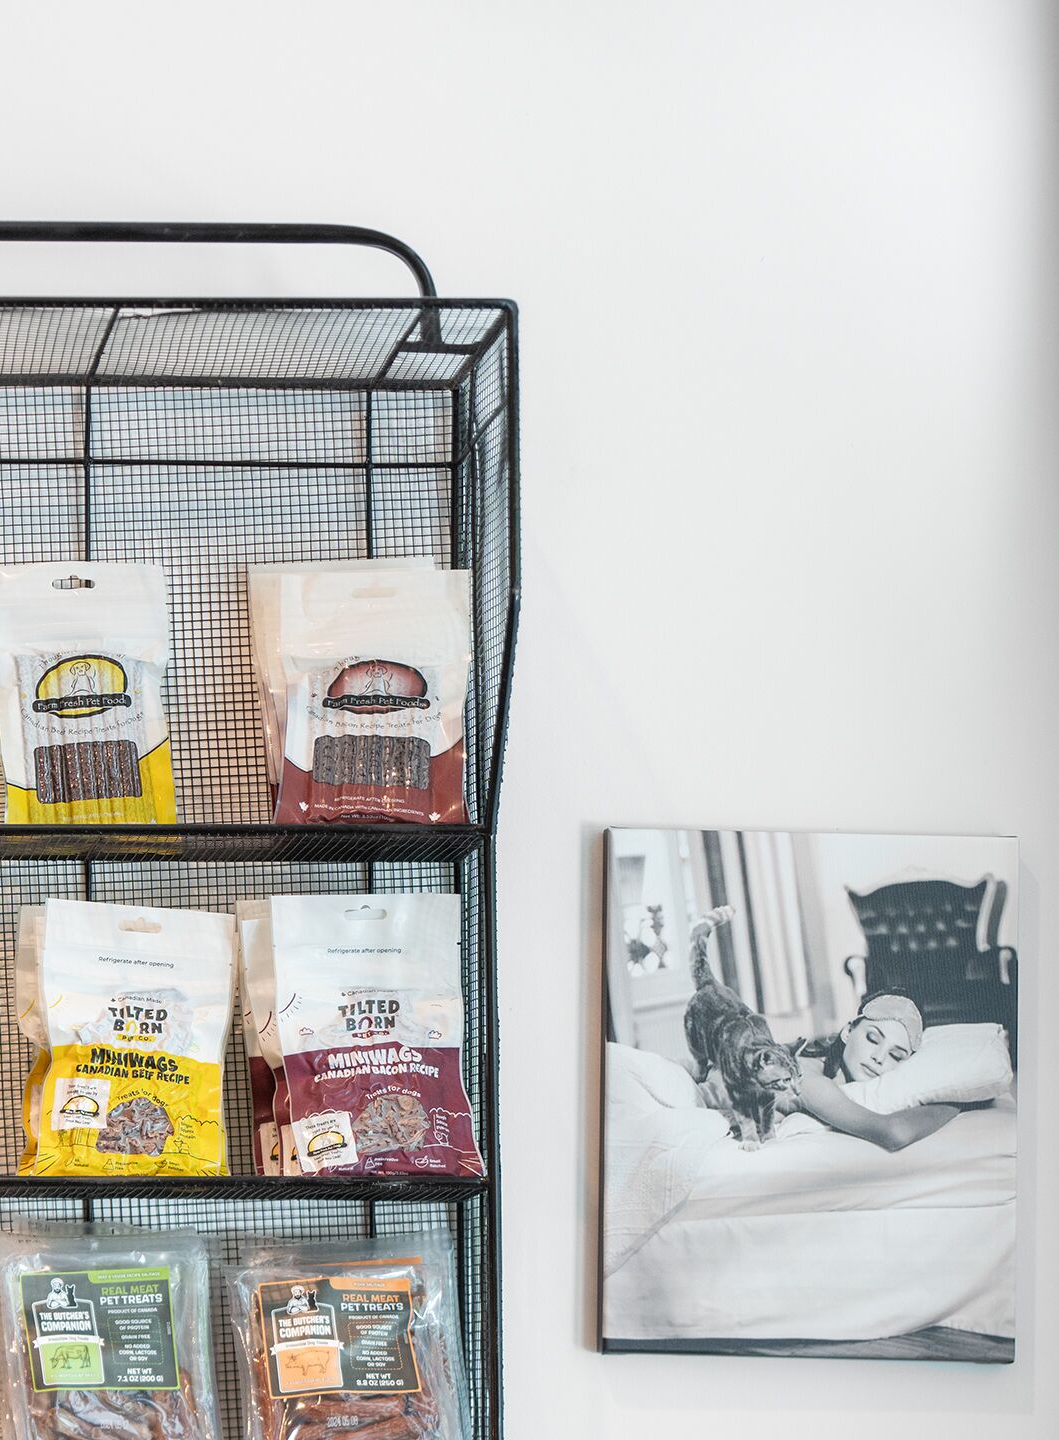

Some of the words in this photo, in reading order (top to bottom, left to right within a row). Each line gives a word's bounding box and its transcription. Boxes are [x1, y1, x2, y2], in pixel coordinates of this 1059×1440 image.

[350, 697, 376, 706] Fresh
[378, 697, 394, 706] Pet
[68, 727, 93, 736] Recipe
[99, 956, 132, 965] Refrigerate
[108, 1005, 168, 1021] TILTED
[338, 999, 400, 1018] TILTED
[91, 1048, 178, 1072] MINIWAGS
[328, 1046, 422, 1070] MINIWAGS
[76, 1064, 129, 1079] CANADIAN
[132, 1069, 152, 1081] BEEF
[156, 1071, 190, 1085] RECIPE
[314, 1064, 371, 1083] CANADIAN
[371, 1063, 408, 1076] BACON
[409, 1063, 440, 1079] RECIPE
[366, 1087, 387, 1100] Treats
[388, 1085, 400, 1093] for
[401, 1088, 422, 1099] dogs
[117, 1089, 140, 1101] Treats
[151, 1094, 169, 1108] dogs
[101, 1287, 128, 1295] REAL
[129, 1284, 159, 1294] MEAT
[99, 1296, 120, 1305] PET
[121, 1294, 163, 1304] TREATS
[342, 1294, 369, 1303] REAL
[370, 1294, 400, 1303] MEAT
[341, 1303, 363, 1312] PET
[364, 1302, 404, 1311] TREATS
[39, 1312, 53, 1320] THE
[53, 1311, 90, 1320] BUTCHER'S
[41, 1320, 91, 1331] COMPANION
[278, 1319, 292, 1328] THE
[293, 1316, 330, 1327] BUTCHER'S
[279, 1325, 332, 1338] COMPANION
[141, 1367, 152, 1375] WT
